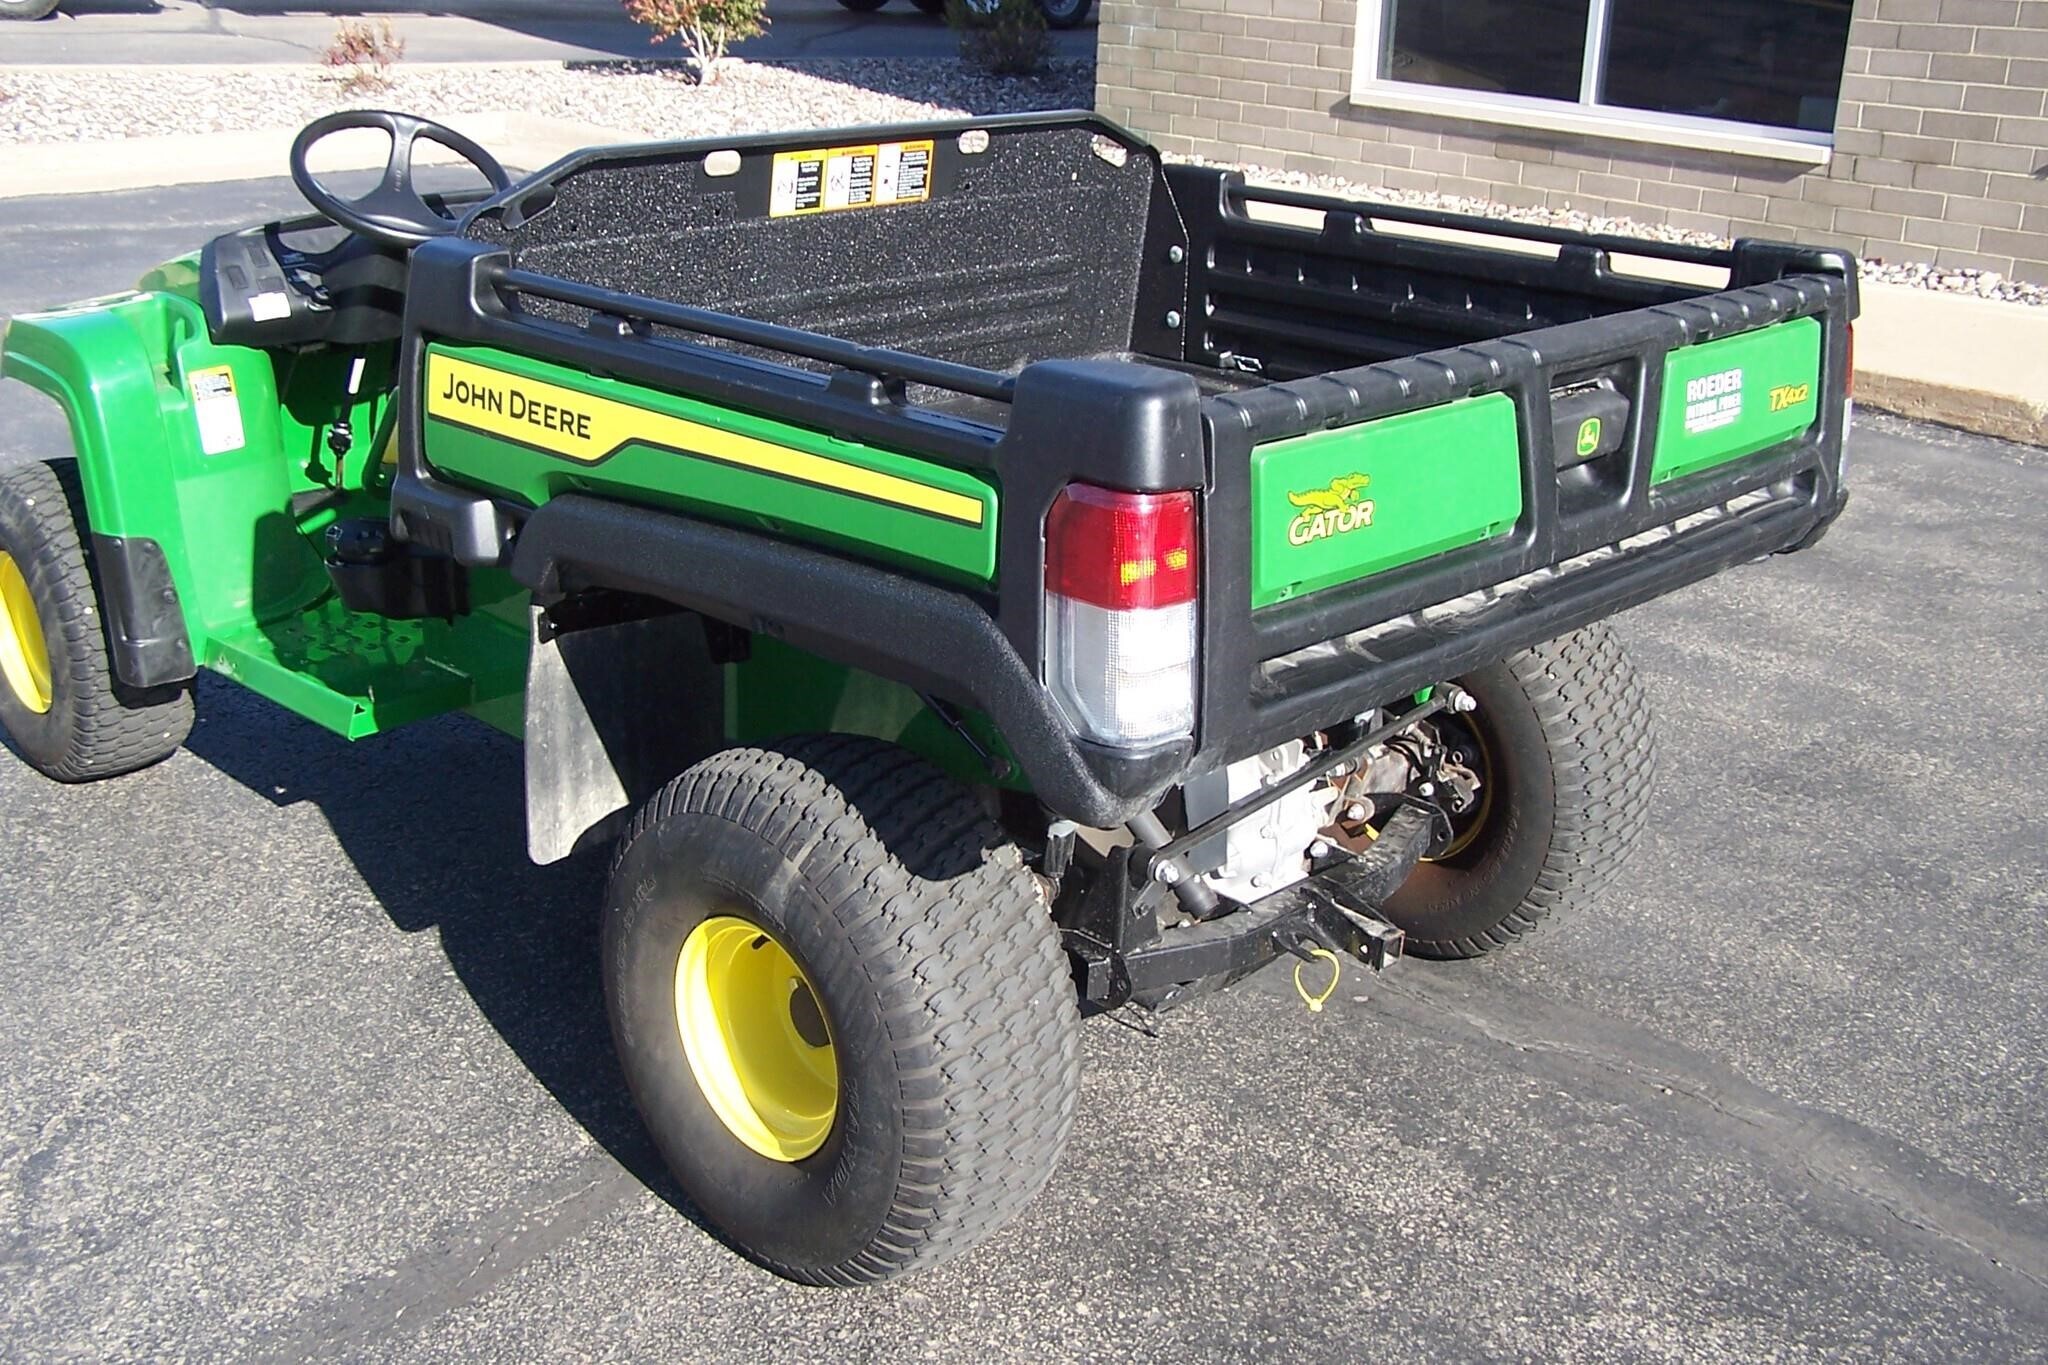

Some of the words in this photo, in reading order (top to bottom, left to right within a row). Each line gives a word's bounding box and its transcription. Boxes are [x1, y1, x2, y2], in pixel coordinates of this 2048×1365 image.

[443, 373, 502, 414] JOHN
[510, 389, 591, 440] DEERE
[1687, 368, 1742, 402] ROEDER
[1288, 500, 1375, 546] GATOR
